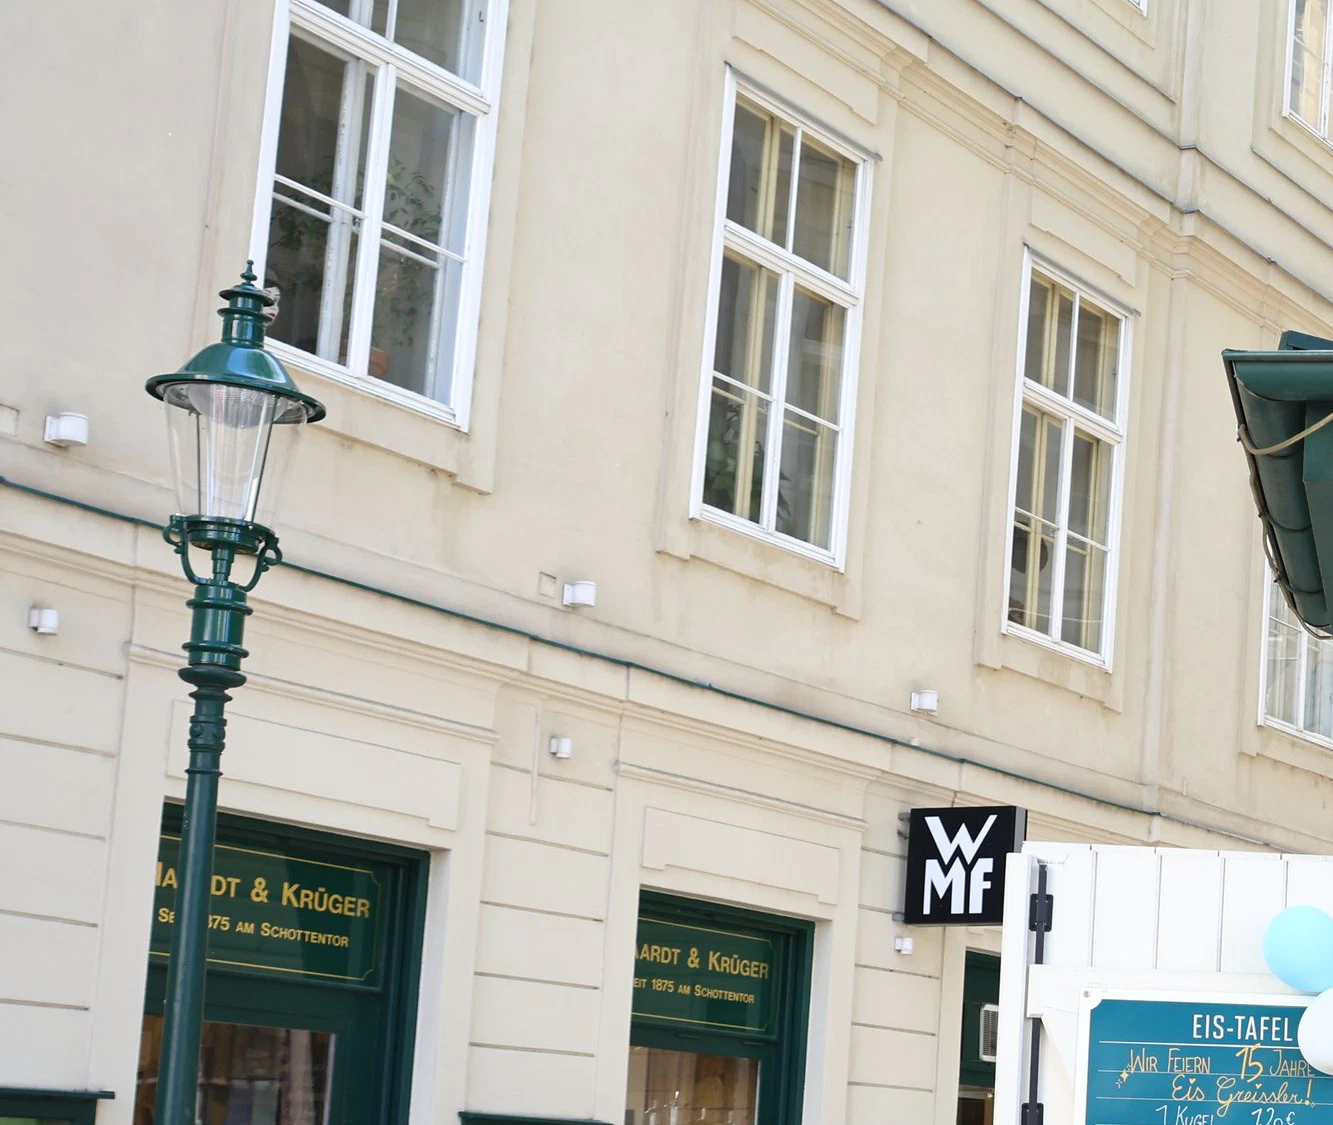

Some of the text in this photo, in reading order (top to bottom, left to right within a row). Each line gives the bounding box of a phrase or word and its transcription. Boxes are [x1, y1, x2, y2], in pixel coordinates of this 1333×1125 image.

[250, 877, 269, 903] &
[235, 921, 255, 934] AM
[260, 922, 350, 948] SCHOTTENTOR
[687, 947, 700, 969] &
[651, 978, 675, 993] 1875
[678, 984, 691, 995] AM
[694, 984, 755, 1004] SCHOTTENTOR
[1192, 1014, 1293, 1041] EIS-TAFEL
[1235, 1043, 1264, 1083] 15
[1171, 1074, 1205, 1101] Eis
